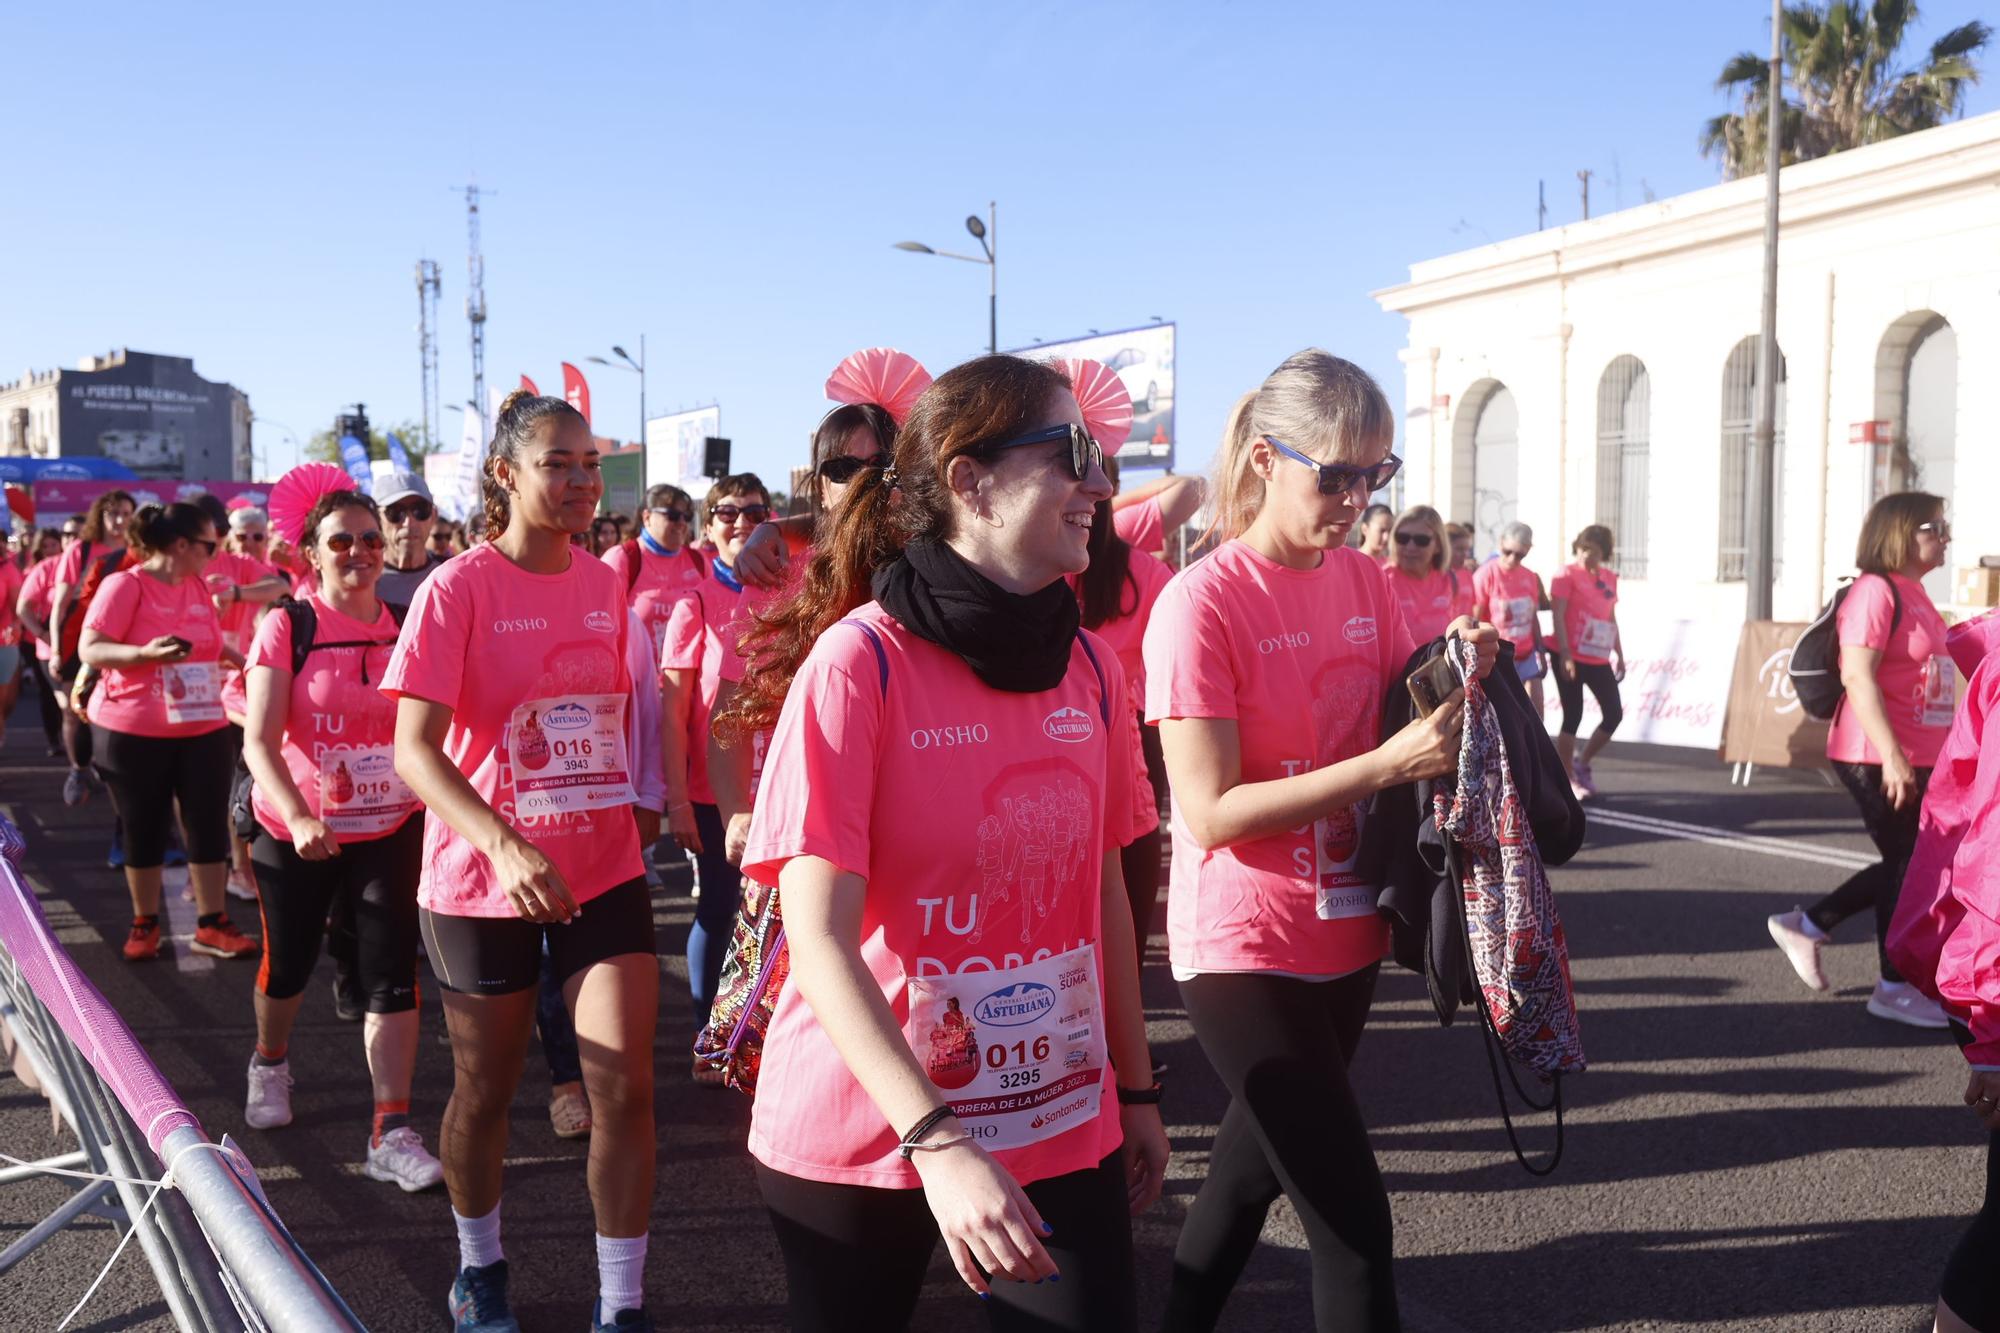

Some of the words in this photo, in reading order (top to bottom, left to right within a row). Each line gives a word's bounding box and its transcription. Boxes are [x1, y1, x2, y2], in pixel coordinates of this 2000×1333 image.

[494, 618, 547, 633] OYSHO
[1637, 692, 1716, 725] Fitness
[312, 713, 344, 734] TU
[1049, 721, 1091, 736] ASTURIANA
[911, 724, 989, 750] OYSHO
[553, 738, 592, 757] 016
[564, 759, 589, 771] 3943
[357, 781, 390, 798] 016
[529, 779, 565, 789] CARRERA
[528, 794, 568, 808] OYSHO
[594, 790, 626, 800] Santander
[1330, 894, 1368, 908] OYSHO
[916, 893, 978, 937] TU
[1059, 973, 1087, 990] SUMA
[981, 996, 1051, 1019] ASTURIANA
[986, 1035, 1050, 1068] 016
[1000, 1068, 1041, 1089] 3295
[952, 1102, 996, 1114] ARRERA
[999, 1099, 1015, 1109] DE
[1018, 1095, 1032, 1105] LA
[1034, 1083, 1063, 1101] MUJER
[1065, 1074, 1087, 1089] 2023
[1044, 1096, 1089, 1125] Santander
